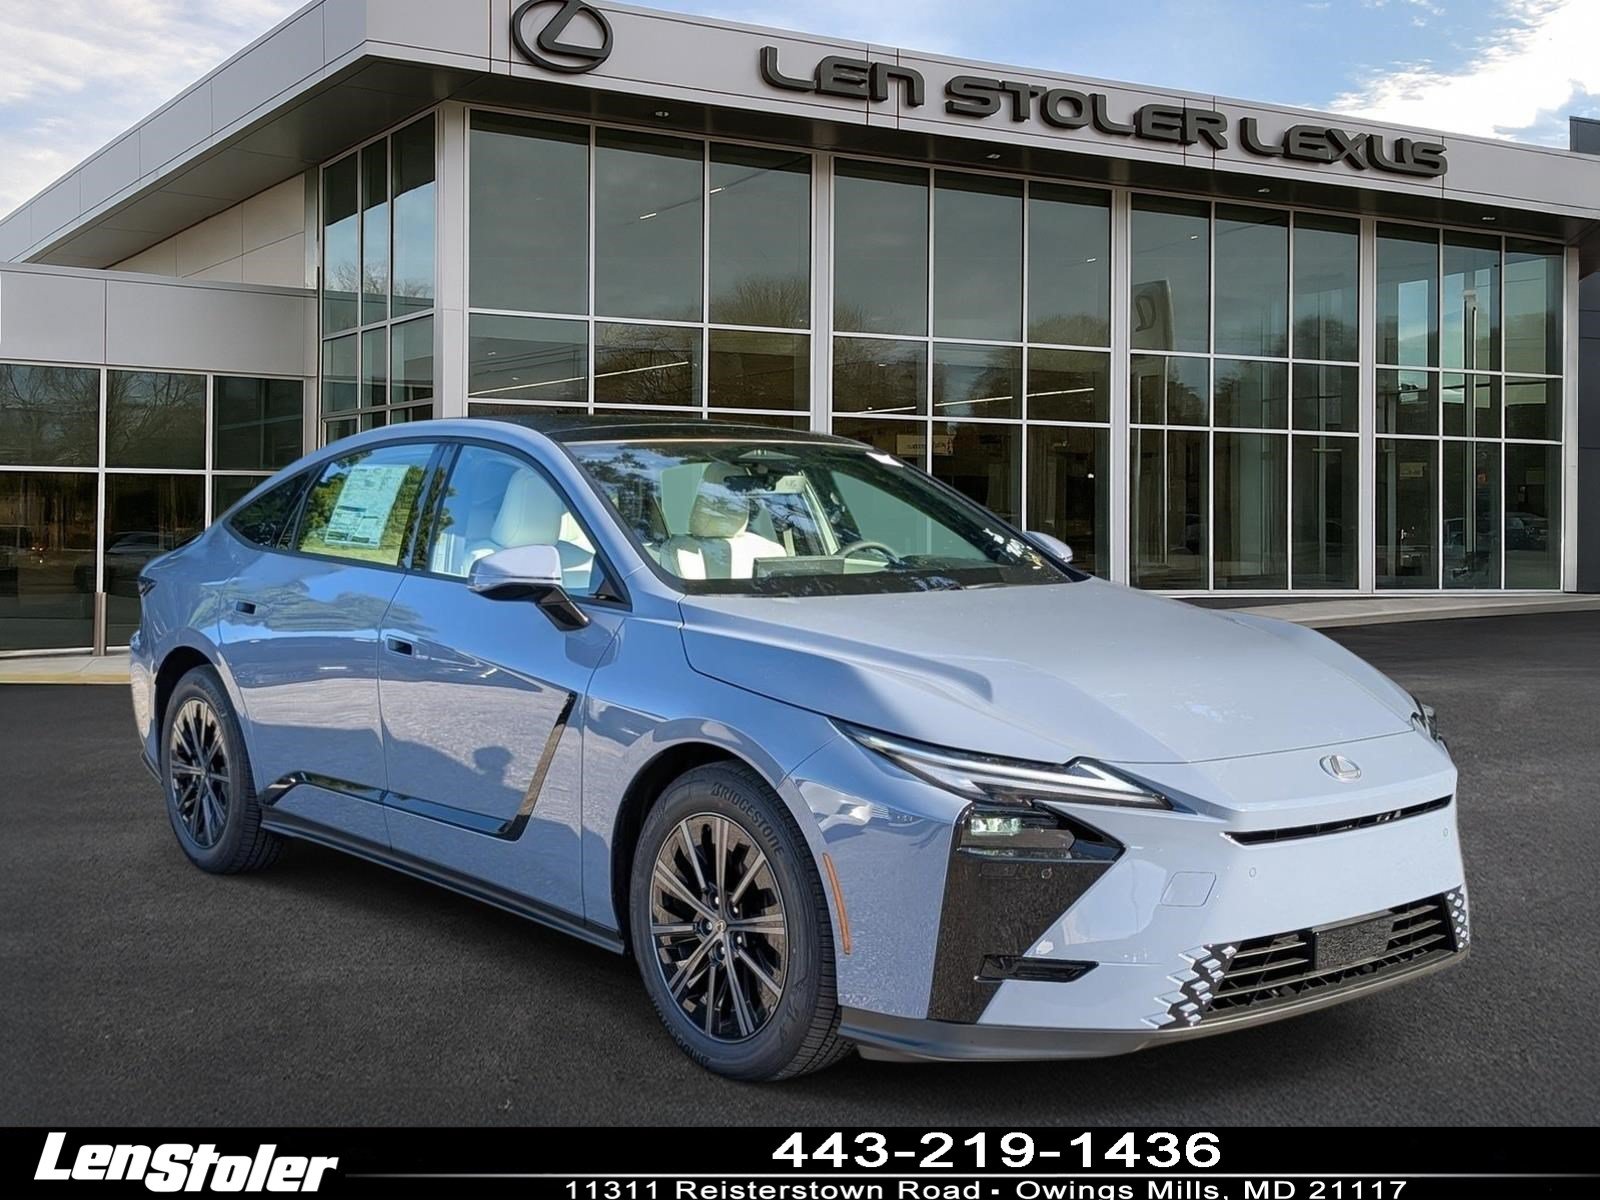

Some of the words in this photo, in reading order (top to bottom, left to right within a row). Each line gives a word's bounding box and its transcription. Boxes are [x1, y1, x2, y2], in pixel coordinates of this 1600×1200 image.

[945, 75, 1228, 149] STOLER
[1240, 117, 1448, 178] LEXUS
[710, 782, 785, 857] BRIDGESTONE
